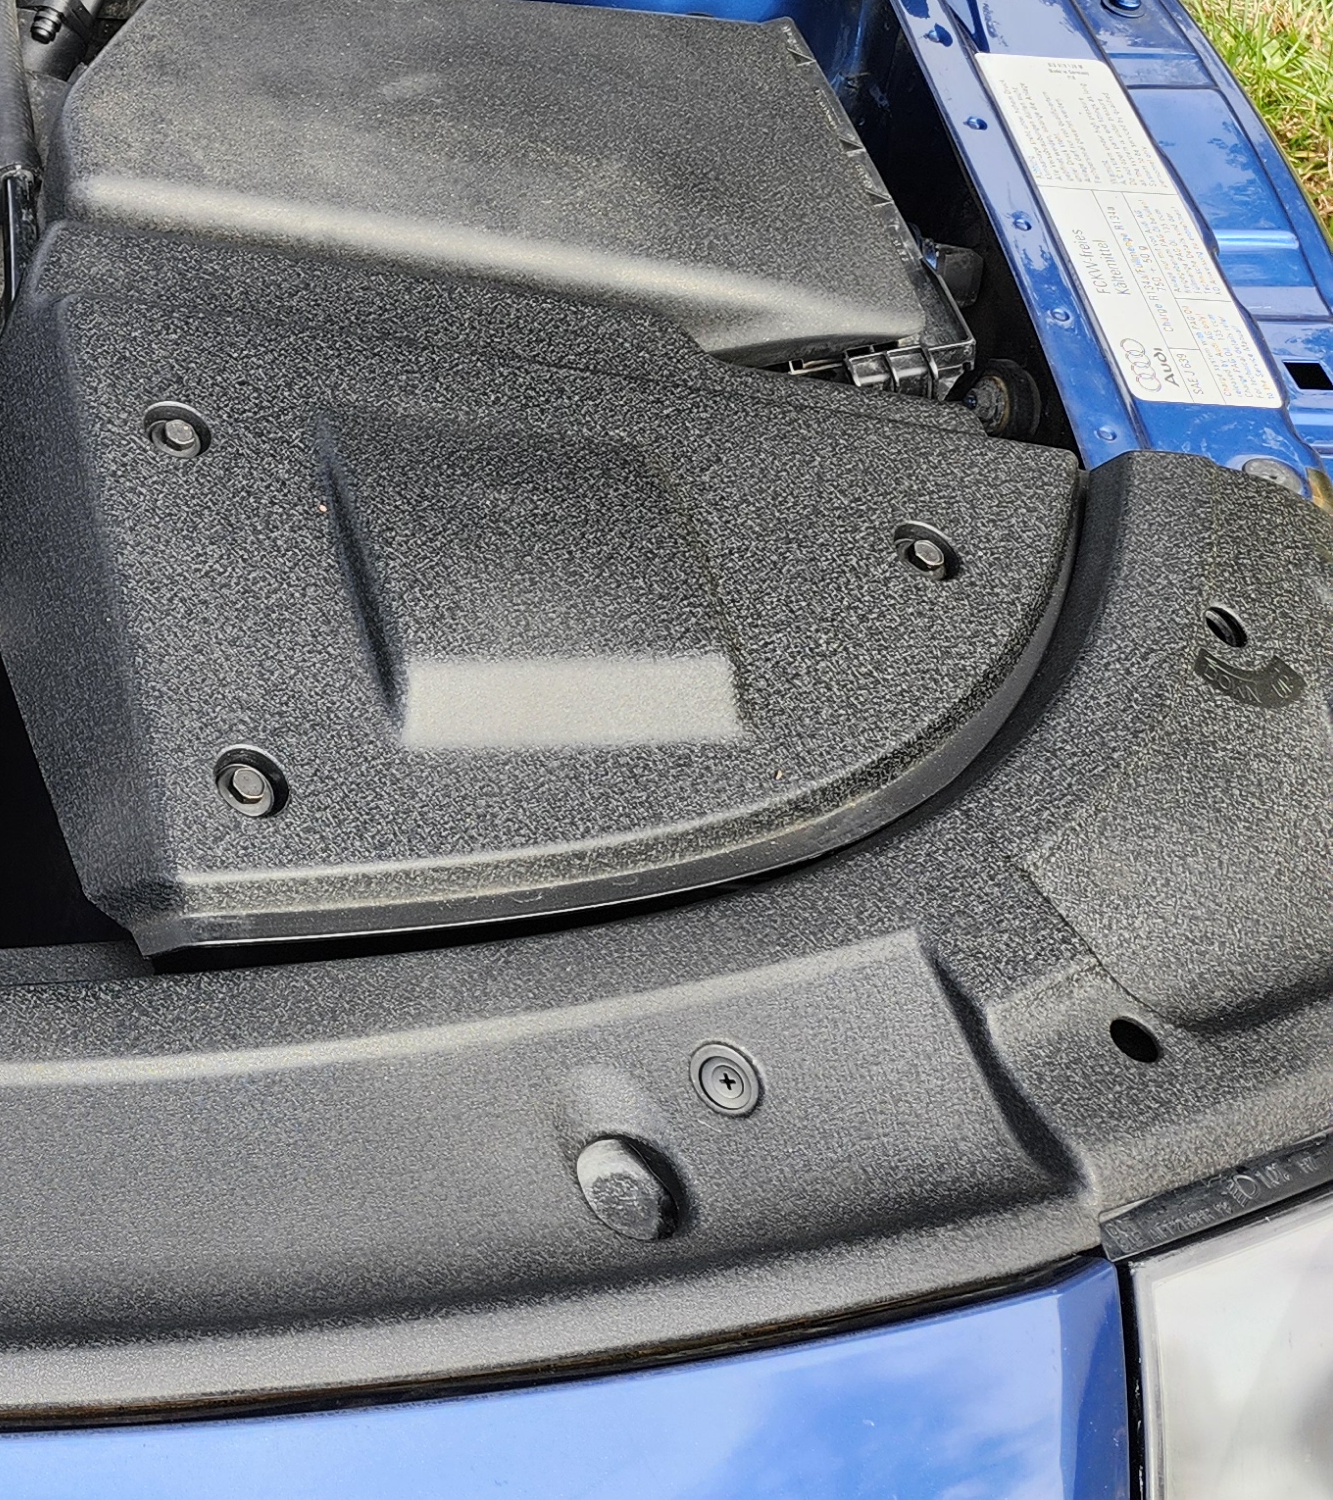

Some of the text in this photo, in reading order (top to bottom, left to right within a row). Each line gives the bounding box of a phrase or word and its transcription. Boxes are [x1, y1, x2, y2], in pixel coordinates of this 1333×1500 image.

[1107, 206, 1125, 231] R134a
[1072, 229, 1111, 294] FCKW-freies
[1092, 239, 1131, 295] Kältemittel
[1139, 253, 1153, 263] 50
[1151, 277, 1167, 291] 750
[1154, 303, 1174, 332] Charge
[1204, 331, 1215, 341] AG
[1153, 347, 1180, 387] Audi
[1176, 353, 1192, 369] 639
[1204, 347, 1220, 371] system
[1187, 378, 1205, 395] SAE
[1216, 373, 1232, 397] Charge
[1238, 375, 1254, 398] Charge
